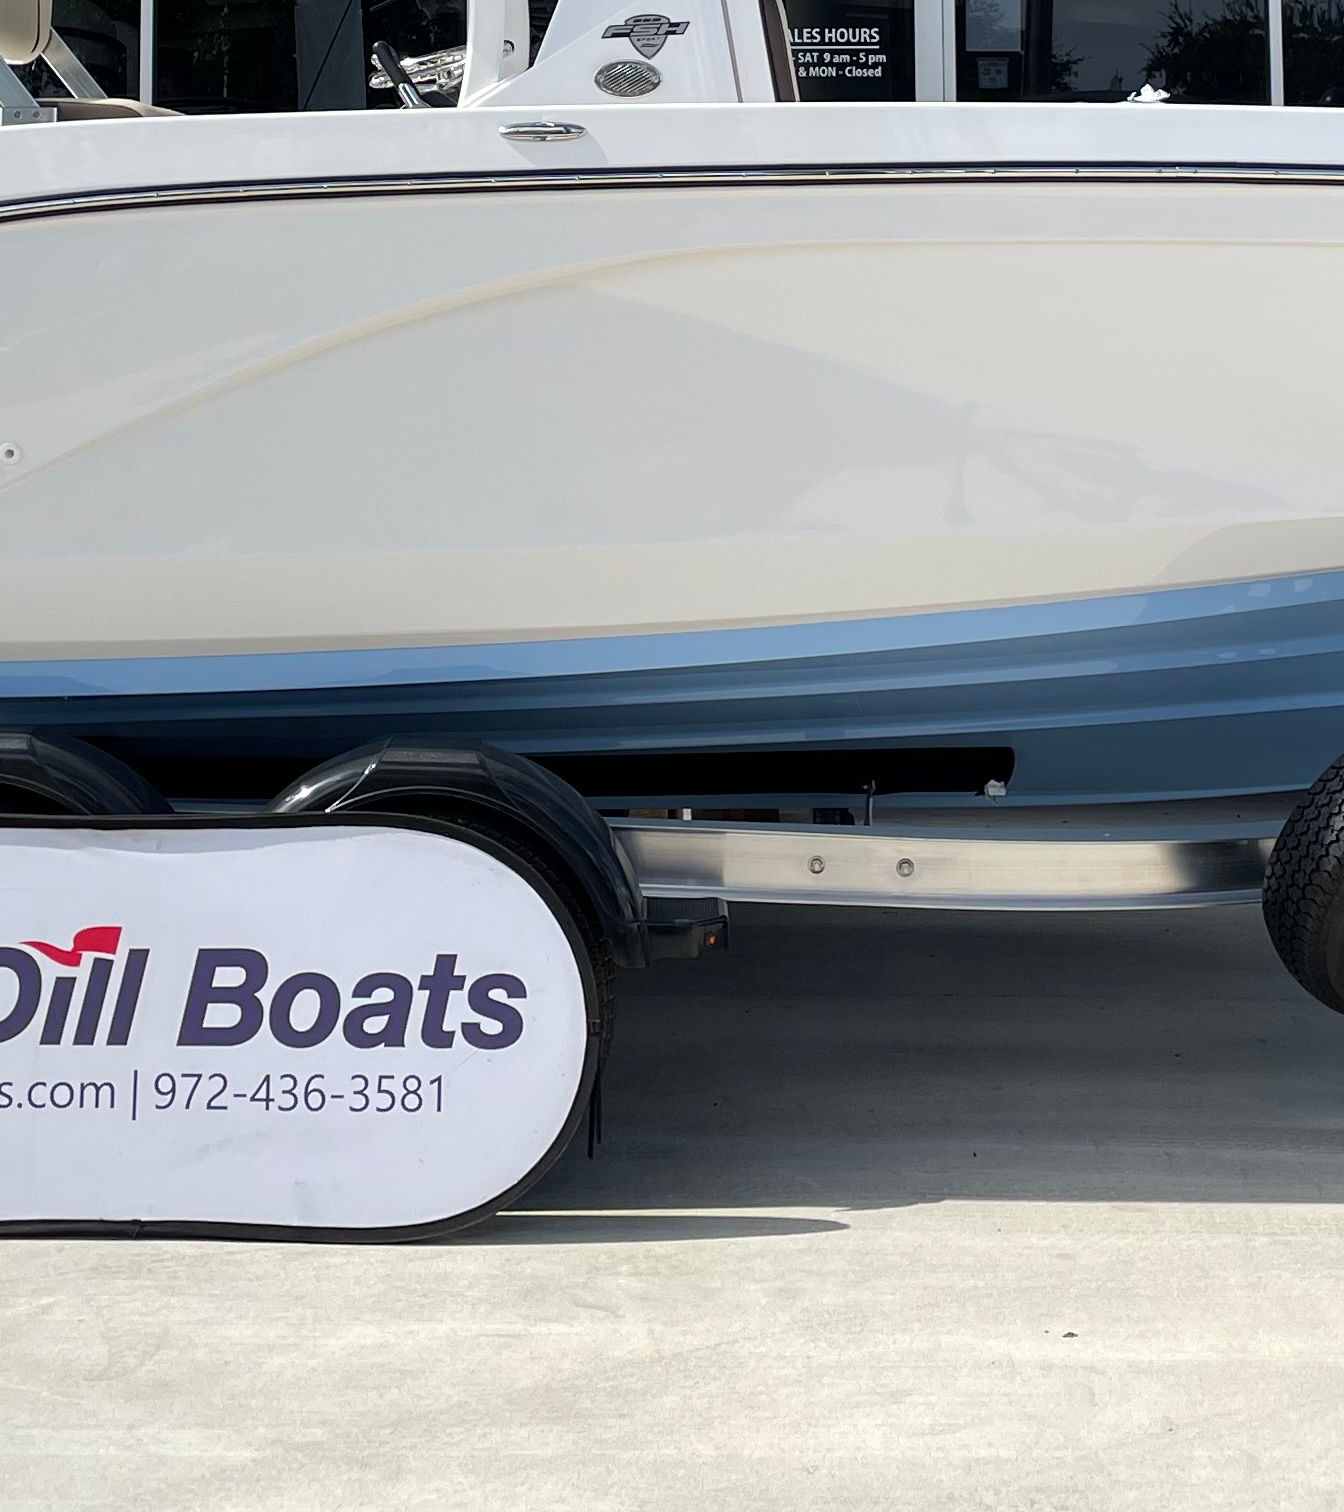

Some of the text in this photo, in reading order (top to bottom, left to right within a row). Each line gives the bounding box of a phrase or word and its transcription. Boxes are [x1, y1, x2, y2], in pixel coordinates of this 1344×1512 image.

[788, 28, 880, 43] LES HOURS
[797, 52, 819, 63] SAT
[823, 52, 831, 63] 9
[832, 54, 851, 63] am
[859, 52, 866, 63] 5
[868, 54, 887, 66] pm
[798, 66, 807, 77] &
[808, 66, 836, 77] MON
[844, 65, 882, 77] Closed
[176, 947, 528, 1051] Boats
[152, 1072, 444, 1113] 972-436-3581
